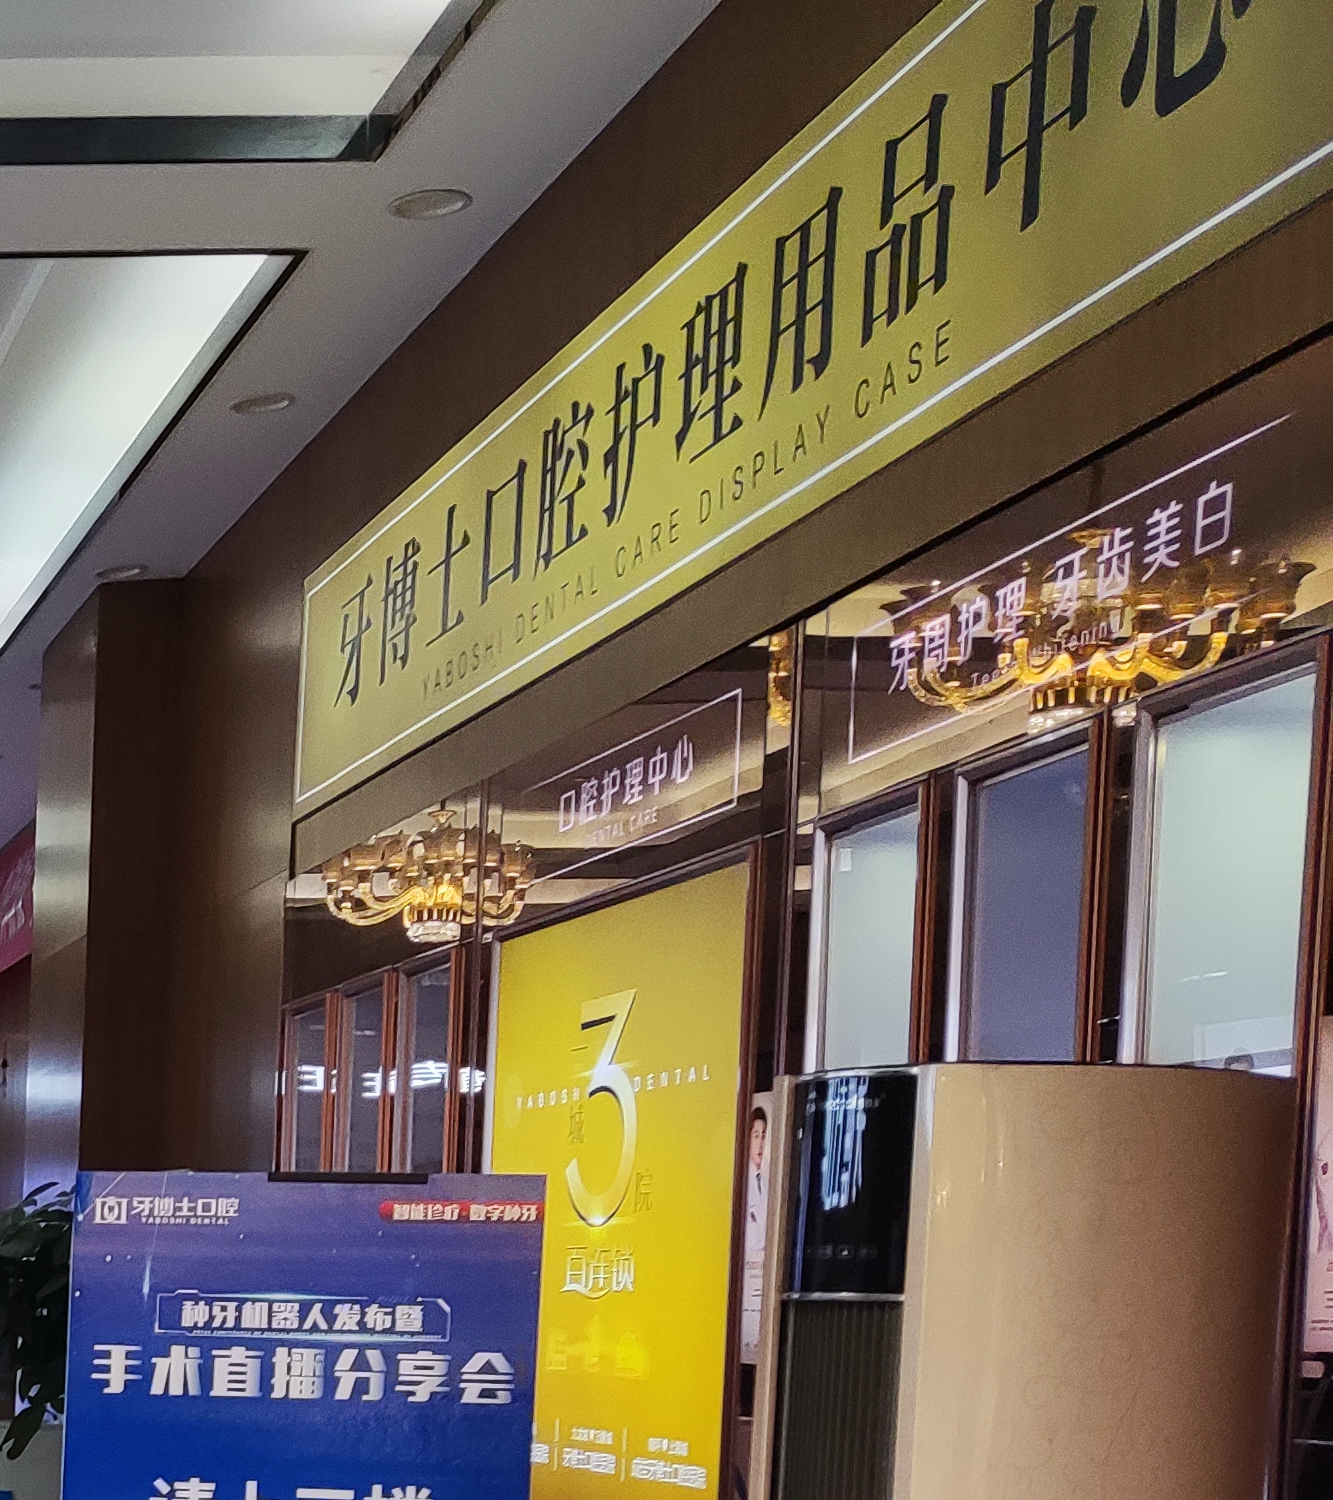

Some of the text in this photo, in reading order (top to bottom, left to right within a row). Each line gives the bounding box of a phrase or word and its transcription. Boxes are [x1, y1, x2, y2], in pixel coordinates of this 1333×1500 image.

[422, 319, 954, 701] YABOSHI DENTAL CARE DISPLAY CASE
[888, 480, 1234, 696] 牙周护理 牙齿美白
[559, 734, 694, 833] 口腔护理中心
[633, 1064, 711, 1094] DENTAL
[131, 1197, 239, 1217] 牙博士口腔
[181, 1300, 423, 1332] 种牙机器人发布暨
[91, 1344, 515, 1405] 手术直播分享会
